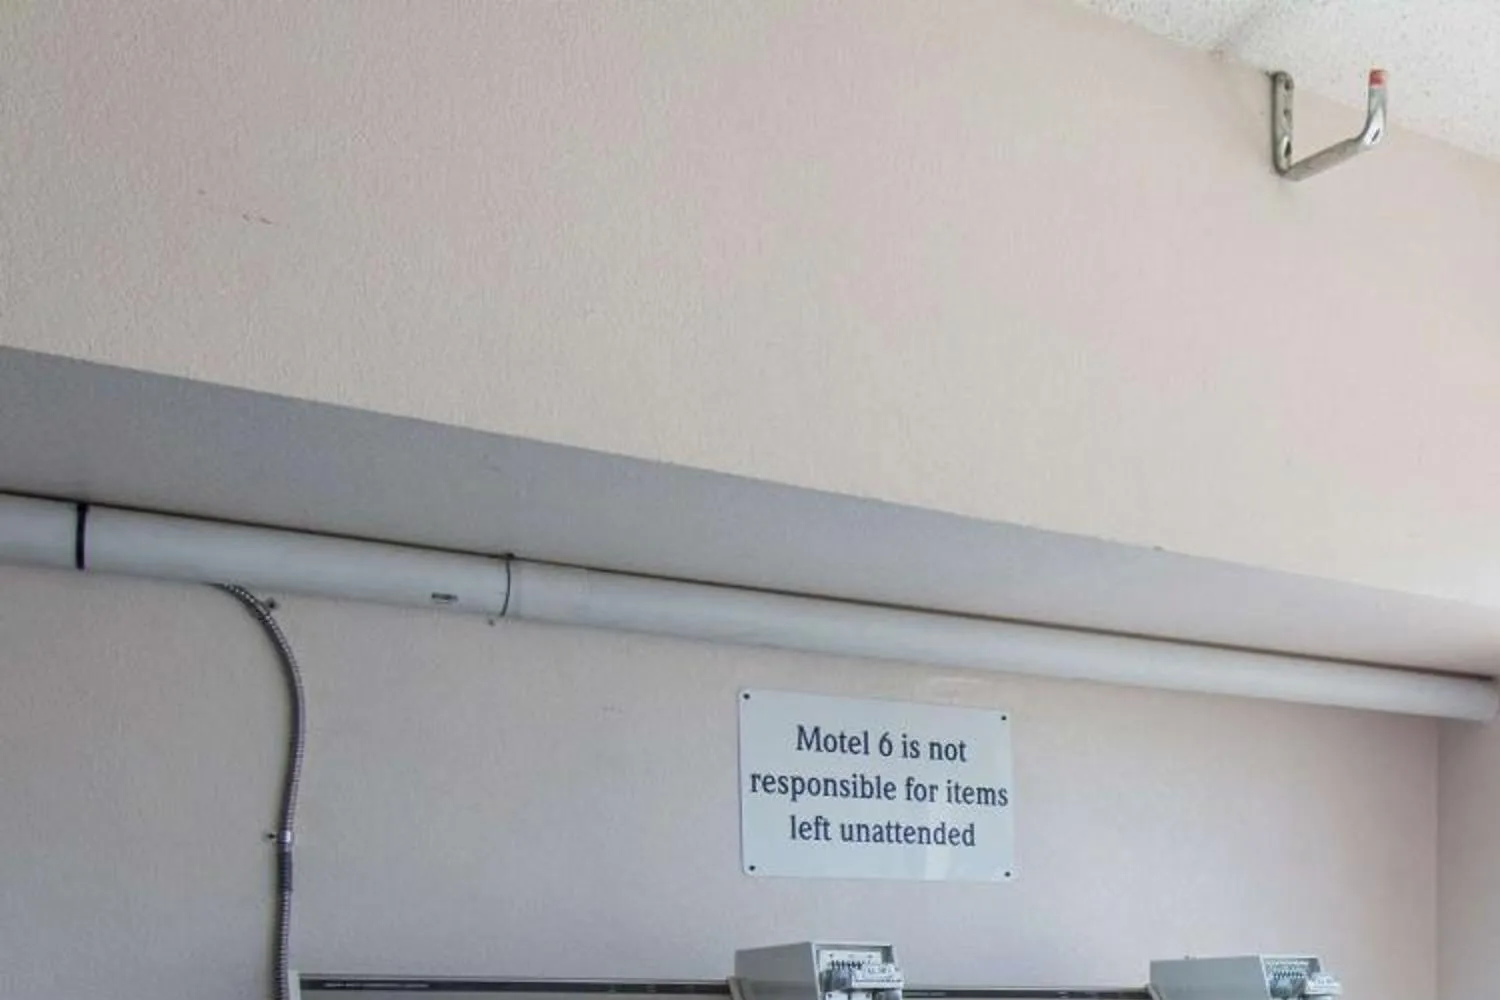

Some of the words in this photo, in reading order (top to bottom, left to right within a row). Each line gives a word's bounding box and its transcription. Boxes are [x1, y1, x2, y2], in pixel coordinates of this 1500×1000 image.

[796, 724, 869, 756] Motel
[878, 731, 894, 757] 6
[901, 732, 921, 759] is
[929, 740, 967, 763] not
[750, 772, 897, 801] responsible
[905, 776, 939, 803] for
[946, 779, 1009, 807] items
[789, 814, 832, 842] left
[840, 820, 976, 847] unattended
